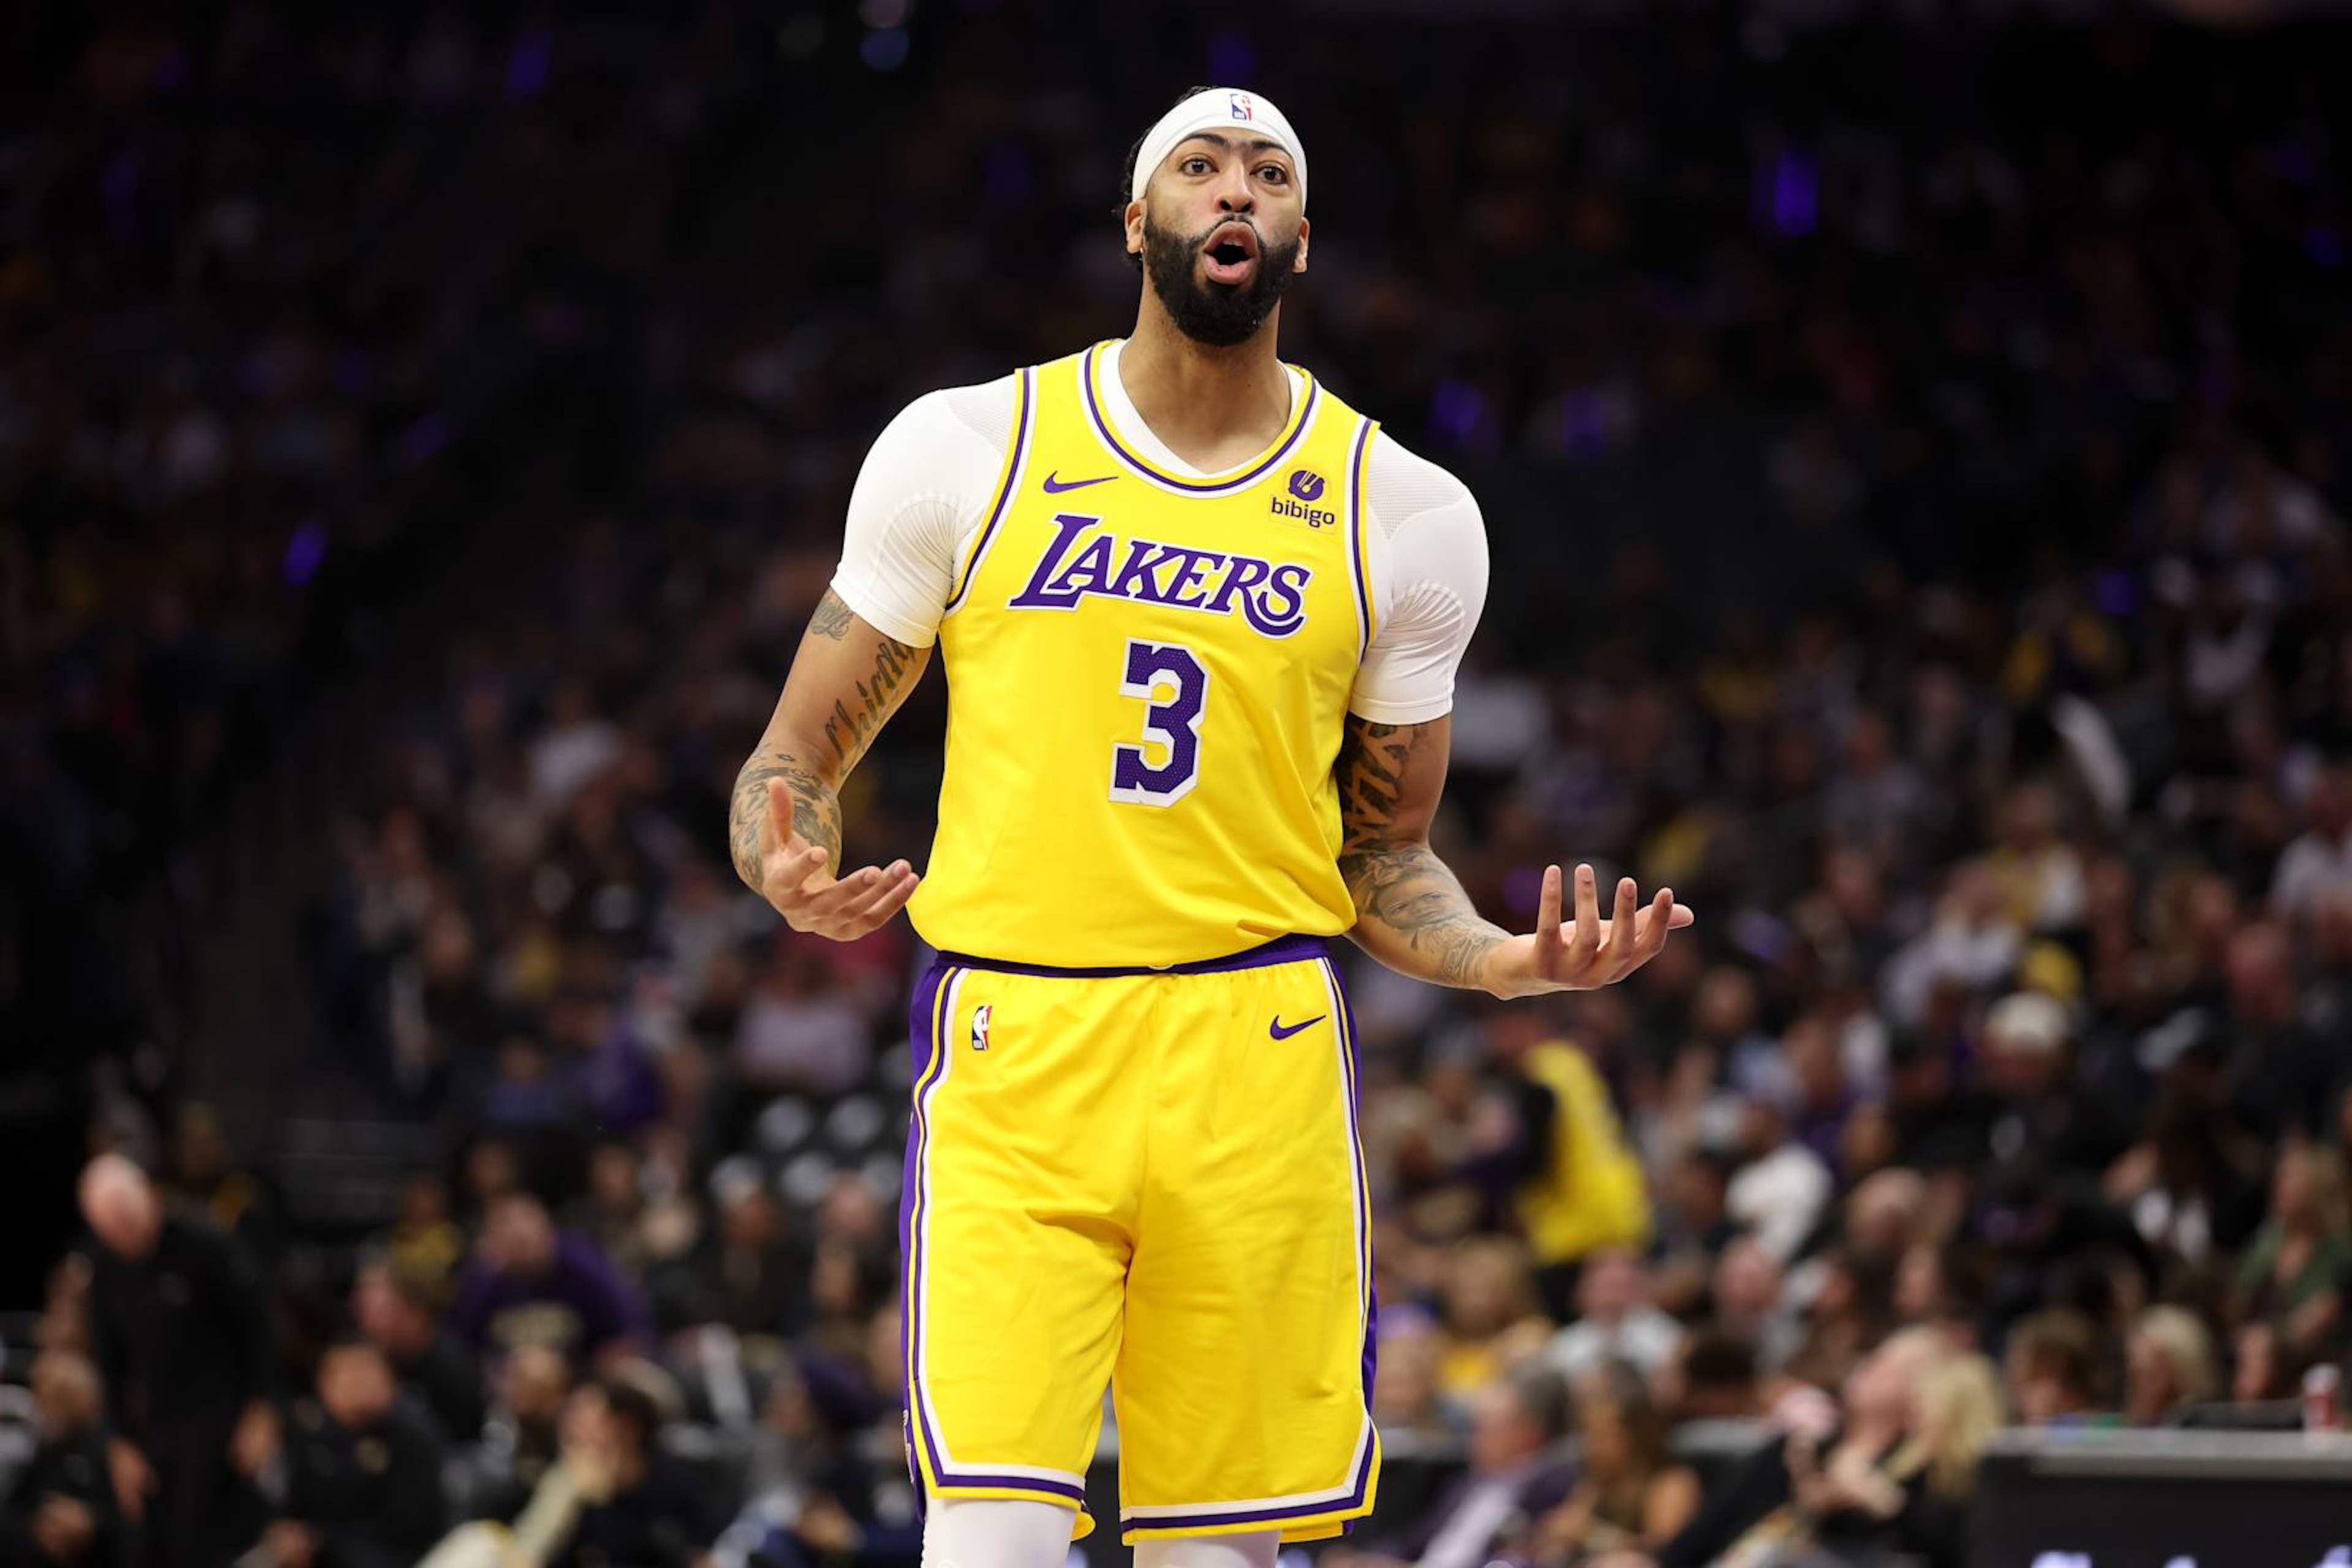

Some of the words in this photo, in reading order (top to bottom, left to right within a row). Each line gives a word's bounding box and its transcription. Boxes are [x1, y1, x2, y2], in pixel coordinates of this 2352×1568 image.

[1006, 512, 1314, 638] LAKERS
[1272, 497, 1335, 528] bibigo
[1109, 638, 1210, 807] 3
